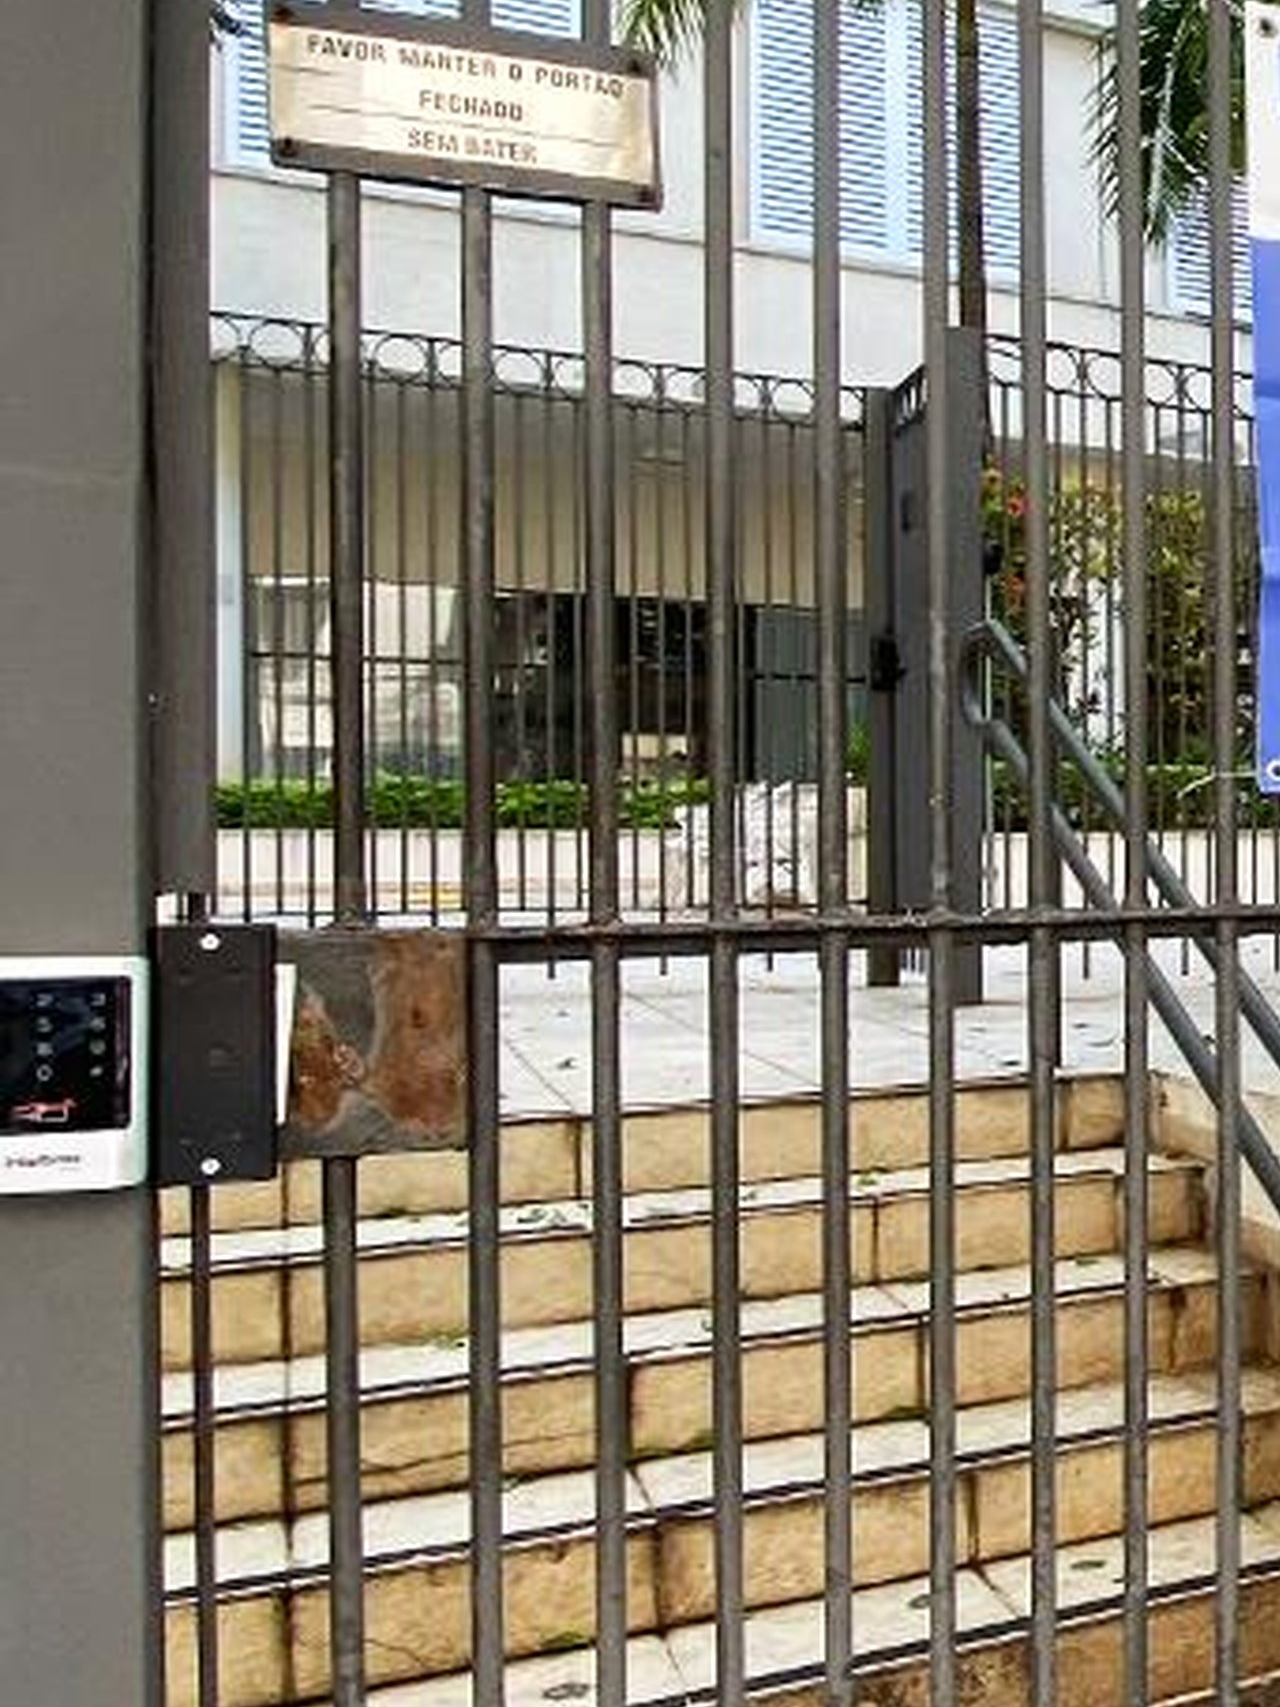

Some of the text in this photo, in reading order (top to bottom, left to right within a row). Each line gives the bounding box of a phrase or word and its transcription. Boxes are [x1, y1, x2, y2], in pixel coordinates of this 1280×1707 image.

[306, 33, 387, 63] FAVOR
[398, 48, 498, 80] MANTER
[418, 89, 524, 123] FECHADO
